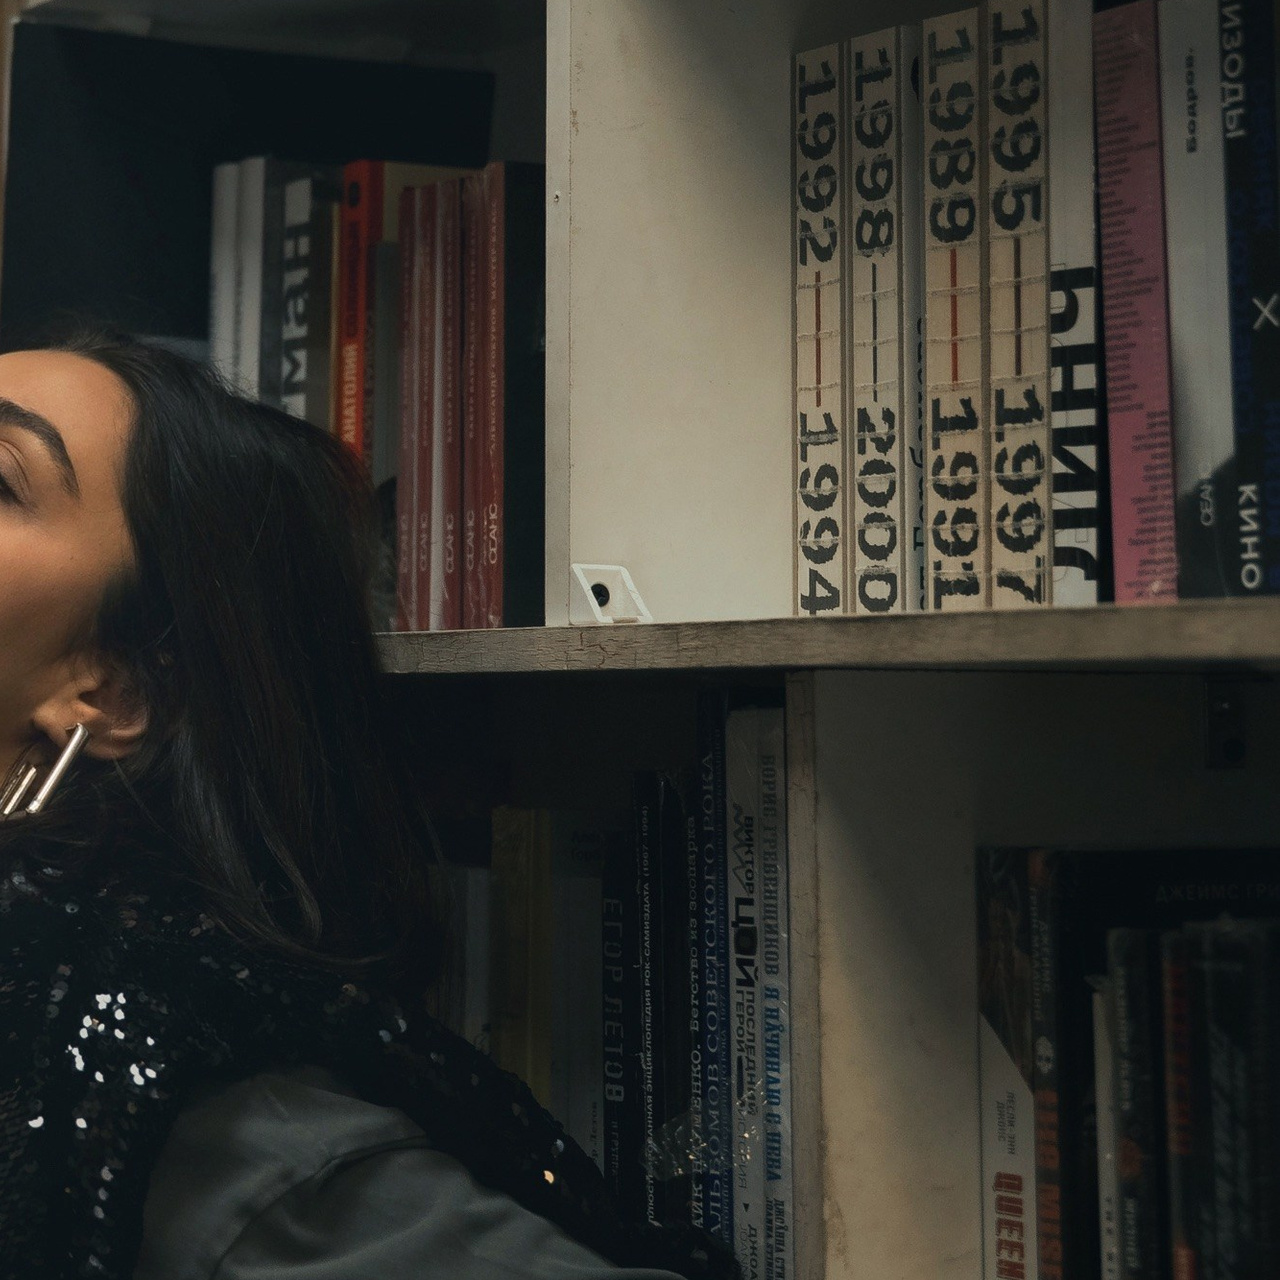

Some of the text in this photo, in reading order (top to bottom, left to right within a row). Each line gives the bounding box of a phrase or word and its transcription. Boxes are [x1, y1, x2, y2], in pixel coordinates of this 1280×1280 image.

[797, 63, 840, 617] 1992 1994
[854, 48, 897, 613] 1998 2000
[928, 27, 981, 611] 1989 1991
[991, 5, 1045, 609] 1995 1997
[1050, 265, 1099, 582] ЛИНЧ
[487, 502, 498, 566] СЕАНС
[1237, 483, 1263, 591] КИНО
[699, 751, 717, 832] РОКА
[686, 816, 699, 912] зоопарка
[732, 815, 759, 988] ВИКТОР ЦОЙ
[603, 896, 624, 983] ЕГОР
[642, 882, 653, 987] РОК-САМИЗДАТА
[689, 918, 699, 941] из
[703, 843, 720, 1054] СОВЕТСКОГО
[604, 993, 625, 1103] ЛЕТОВ
[644, 990, 654, 1092] ЭНЦИКЛОПЕДИЯ
[745, 990, 759, 1117] ПОСЛЕДНИЙ
[691, 1183, 704, 1231] АЙК
